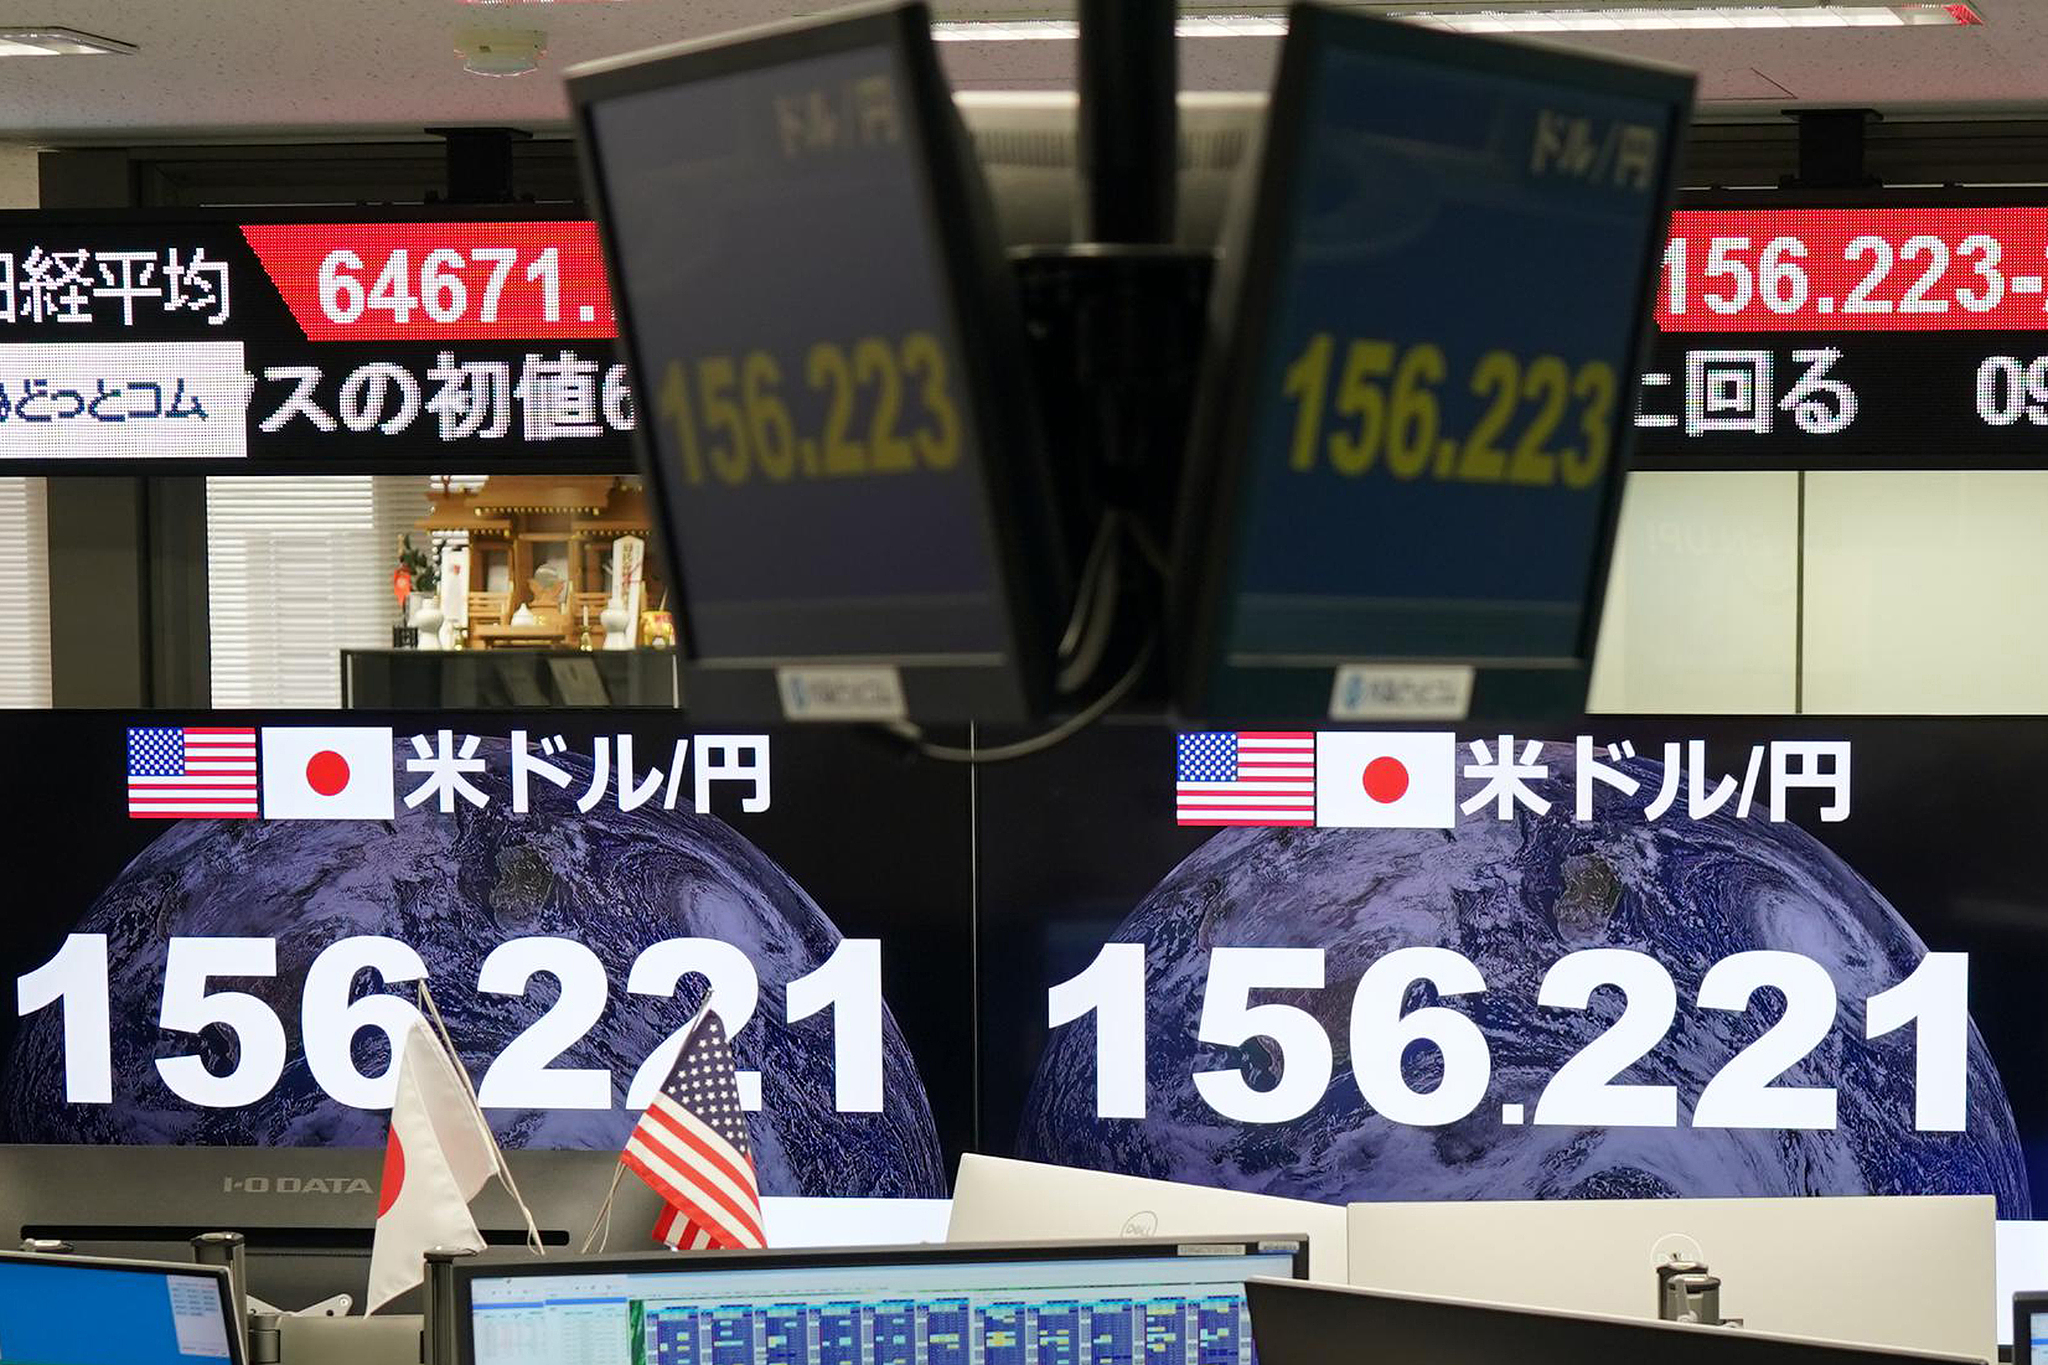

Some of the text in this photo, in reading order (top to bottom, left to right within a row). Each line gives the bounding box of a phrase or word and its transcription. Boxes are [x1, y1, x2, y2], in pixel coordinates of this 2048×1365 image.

[318, 248, 617, 323] 64671.
[1660, 234, 2048, 315] 156.223-
[246, 350, 638, 441] スの初値6
[656, 331, 961, 486] 156.223
[1283, 332, 1617, 491] 156.223
[403, 730, 771, 815] 米ドル/円
[1459, 734, 1851, 823] 米ドル/円
[18, 934, 884, 1114] 156221
[1048, 943, 1969, 1132] 156.221
[276, 1177, 374, 1194] DATA
